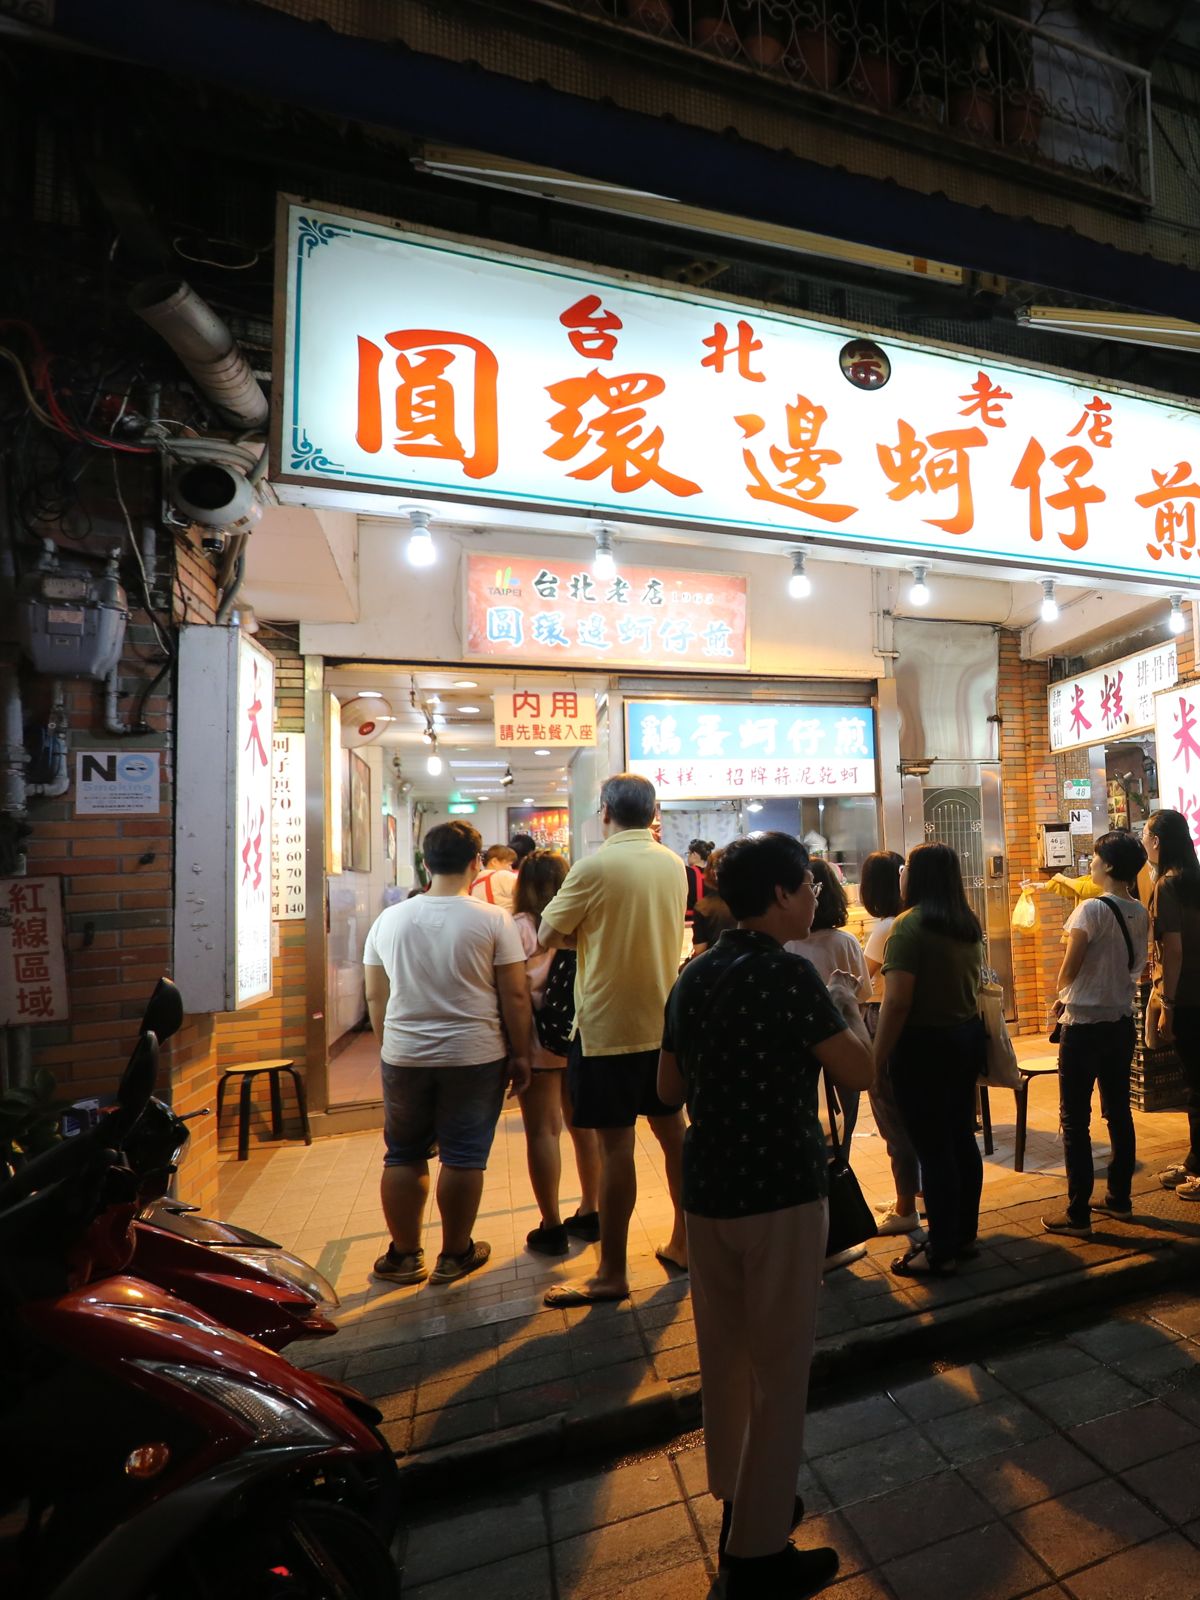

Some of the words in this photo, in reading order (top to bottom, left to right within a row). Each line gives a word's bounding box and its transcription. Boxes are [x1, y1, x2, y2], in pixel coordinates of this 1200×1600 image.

[533, 570, 663, 605] 台北老店
[487, 608, 735, 656] 圓環邊蚵仔煎
[1069, 669, 1130, 741] 米糕
[500, 724, 593, 742] 請先點餐入座
[286, 834, 301, 845] 60
[287, 852, 301, 862] 60
[286, 869, 301, 879] 70
[286, 886, 301, 896] 70
[284, 904, 304, 914] 140
[8, 883, 54, 1018] 紅線區域
